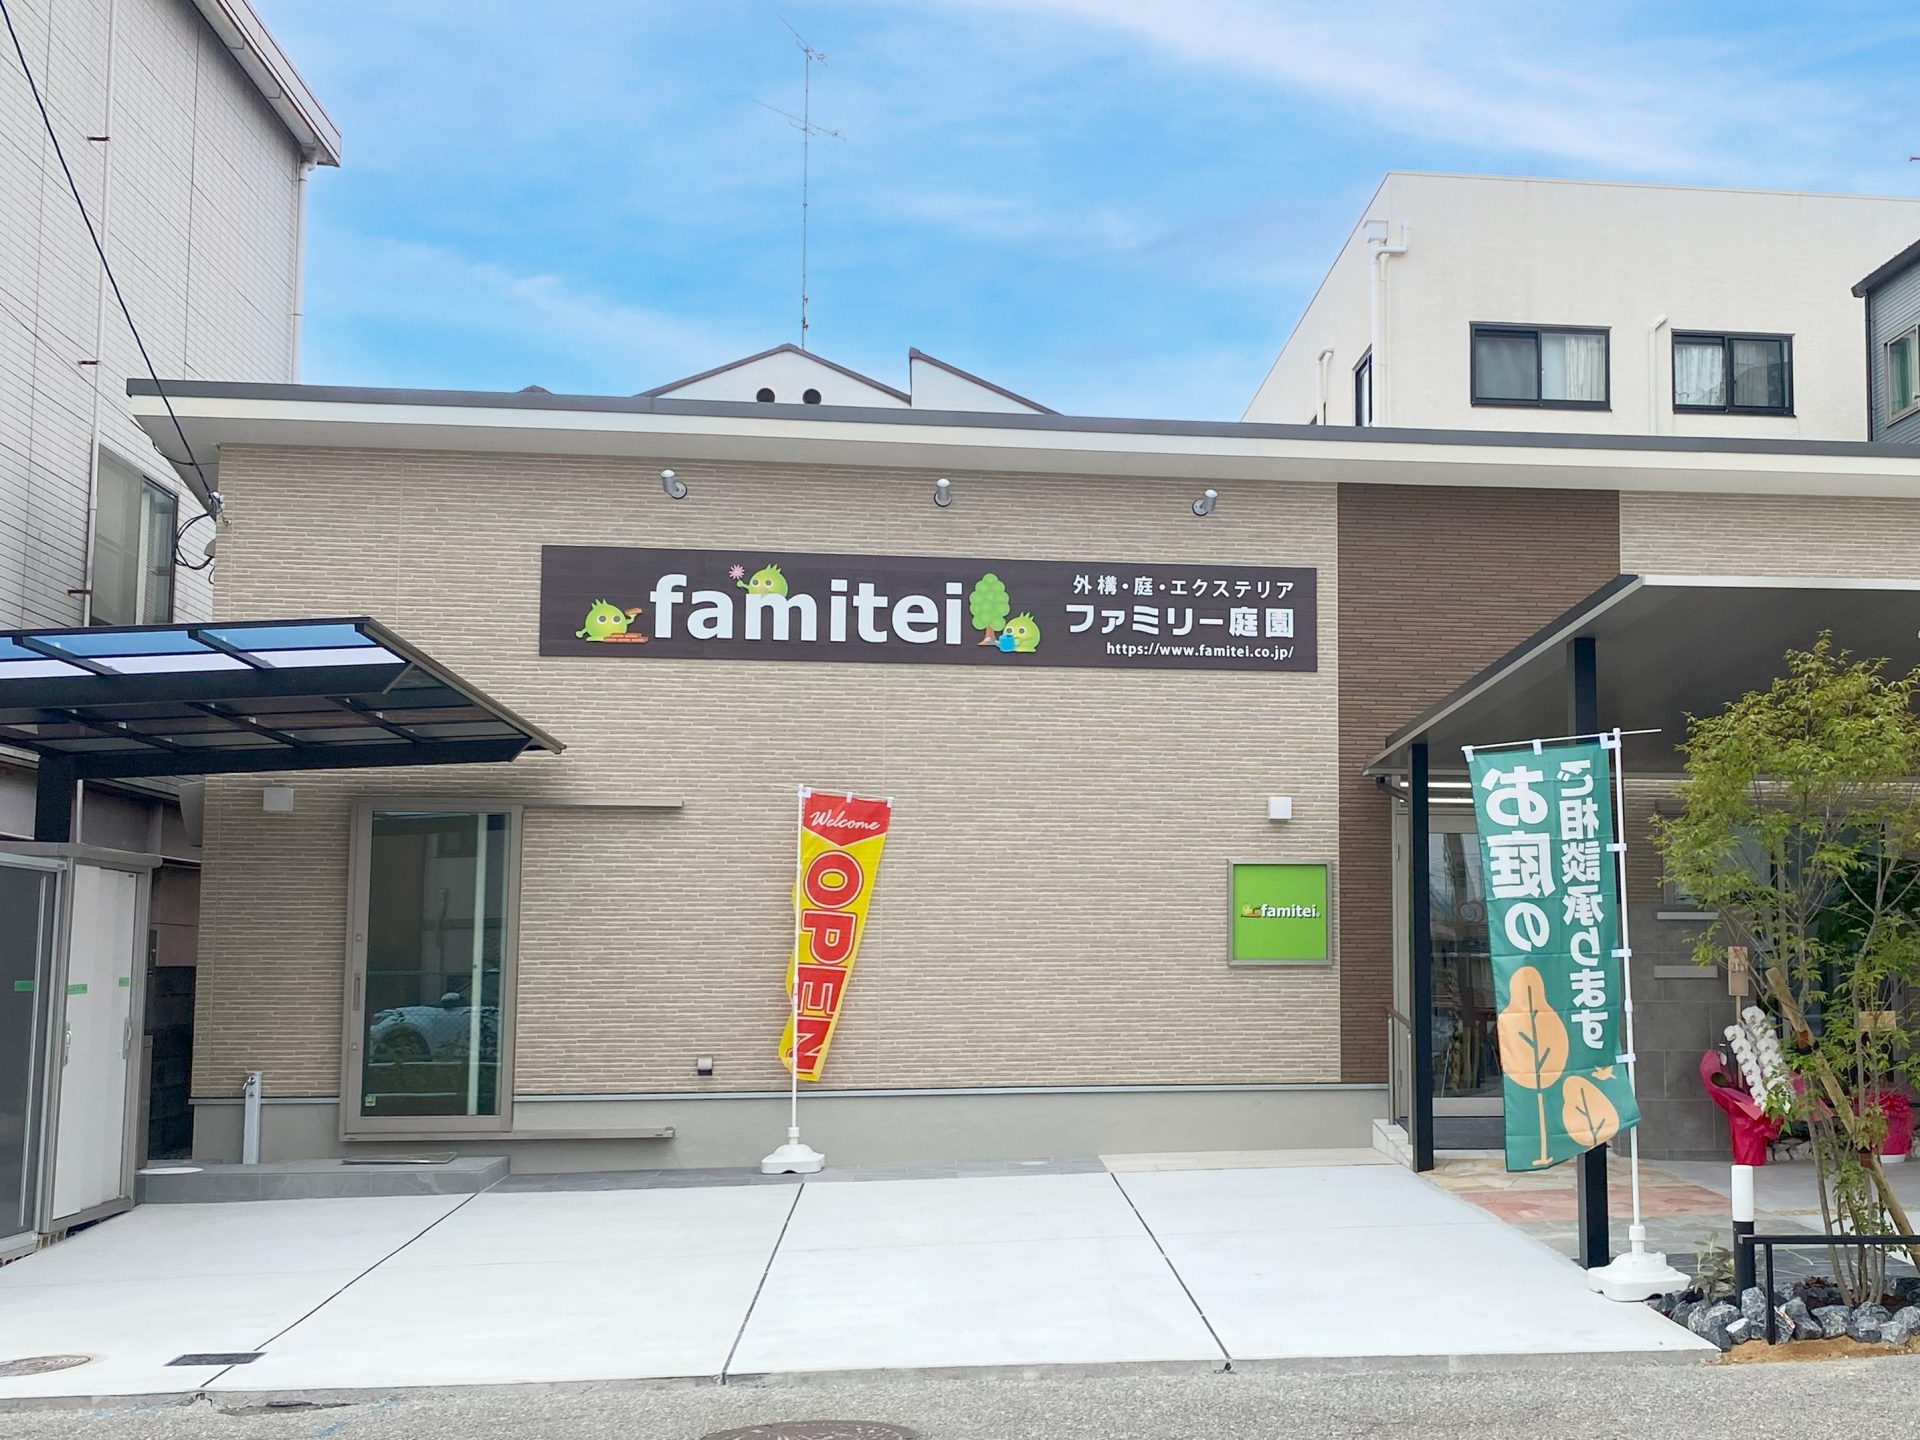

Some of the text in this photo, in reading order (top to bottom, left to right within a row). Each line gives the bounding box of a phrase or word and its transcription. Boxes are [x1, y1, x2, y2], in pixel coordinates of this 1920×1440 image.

[1073, 574, 1294, 599] 外構・庭・エクステリア
[649, 573, 964, 645] famitei
[1065, 604, 1294, 638] ファミリー庭園
[1106, 642, 1294, 660] https://www.famitei.co.jp/
[810, 809, 881, 831] Welcome
[788, 850, 864, 1074] OPEN
